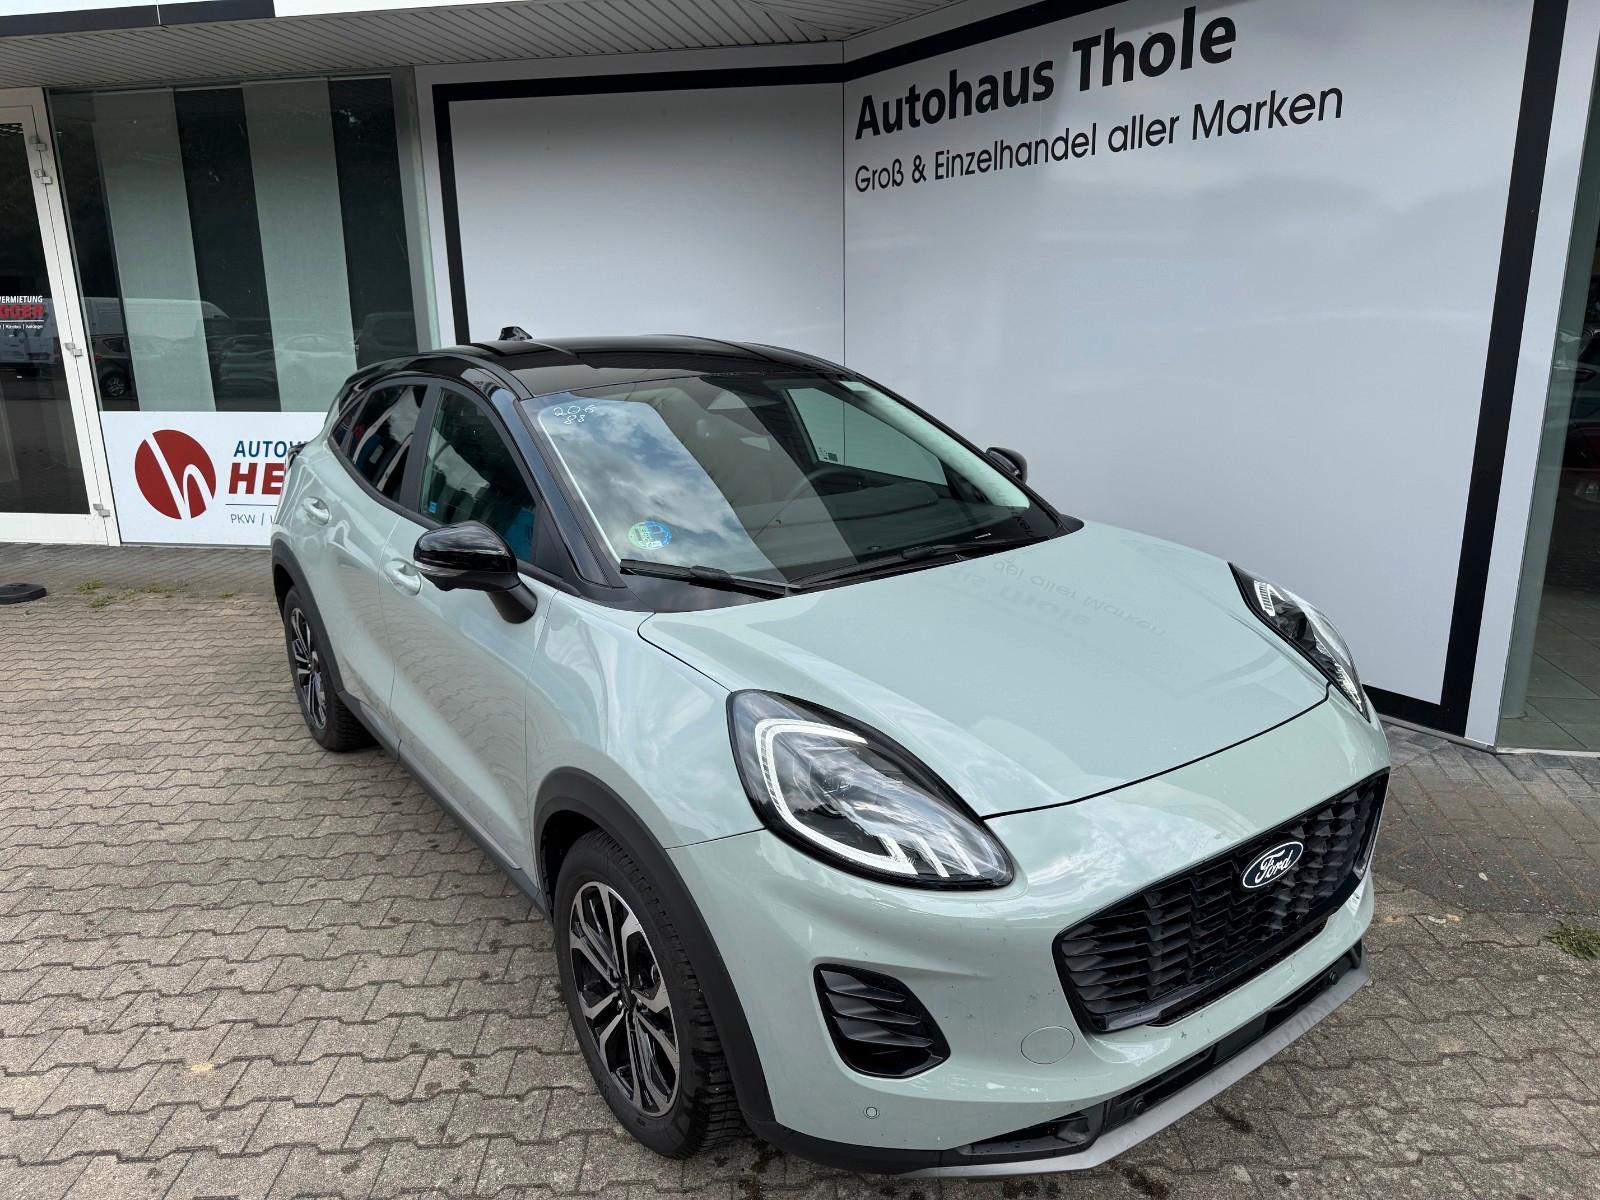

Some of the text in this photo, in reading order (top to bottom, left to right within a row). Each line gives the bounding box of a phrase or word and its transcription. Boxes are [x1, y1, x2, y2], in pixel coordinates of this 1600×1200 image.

[855, 6, 1237, 140] Autohaus Thole
[855, 86, 1344, 193] Groß & Einzelhandel aller Marken
[233, 440, 307, 458] AUTO
[230, 513, 256, 524] PKW
[1255, 849, 1293, 883] Ford
